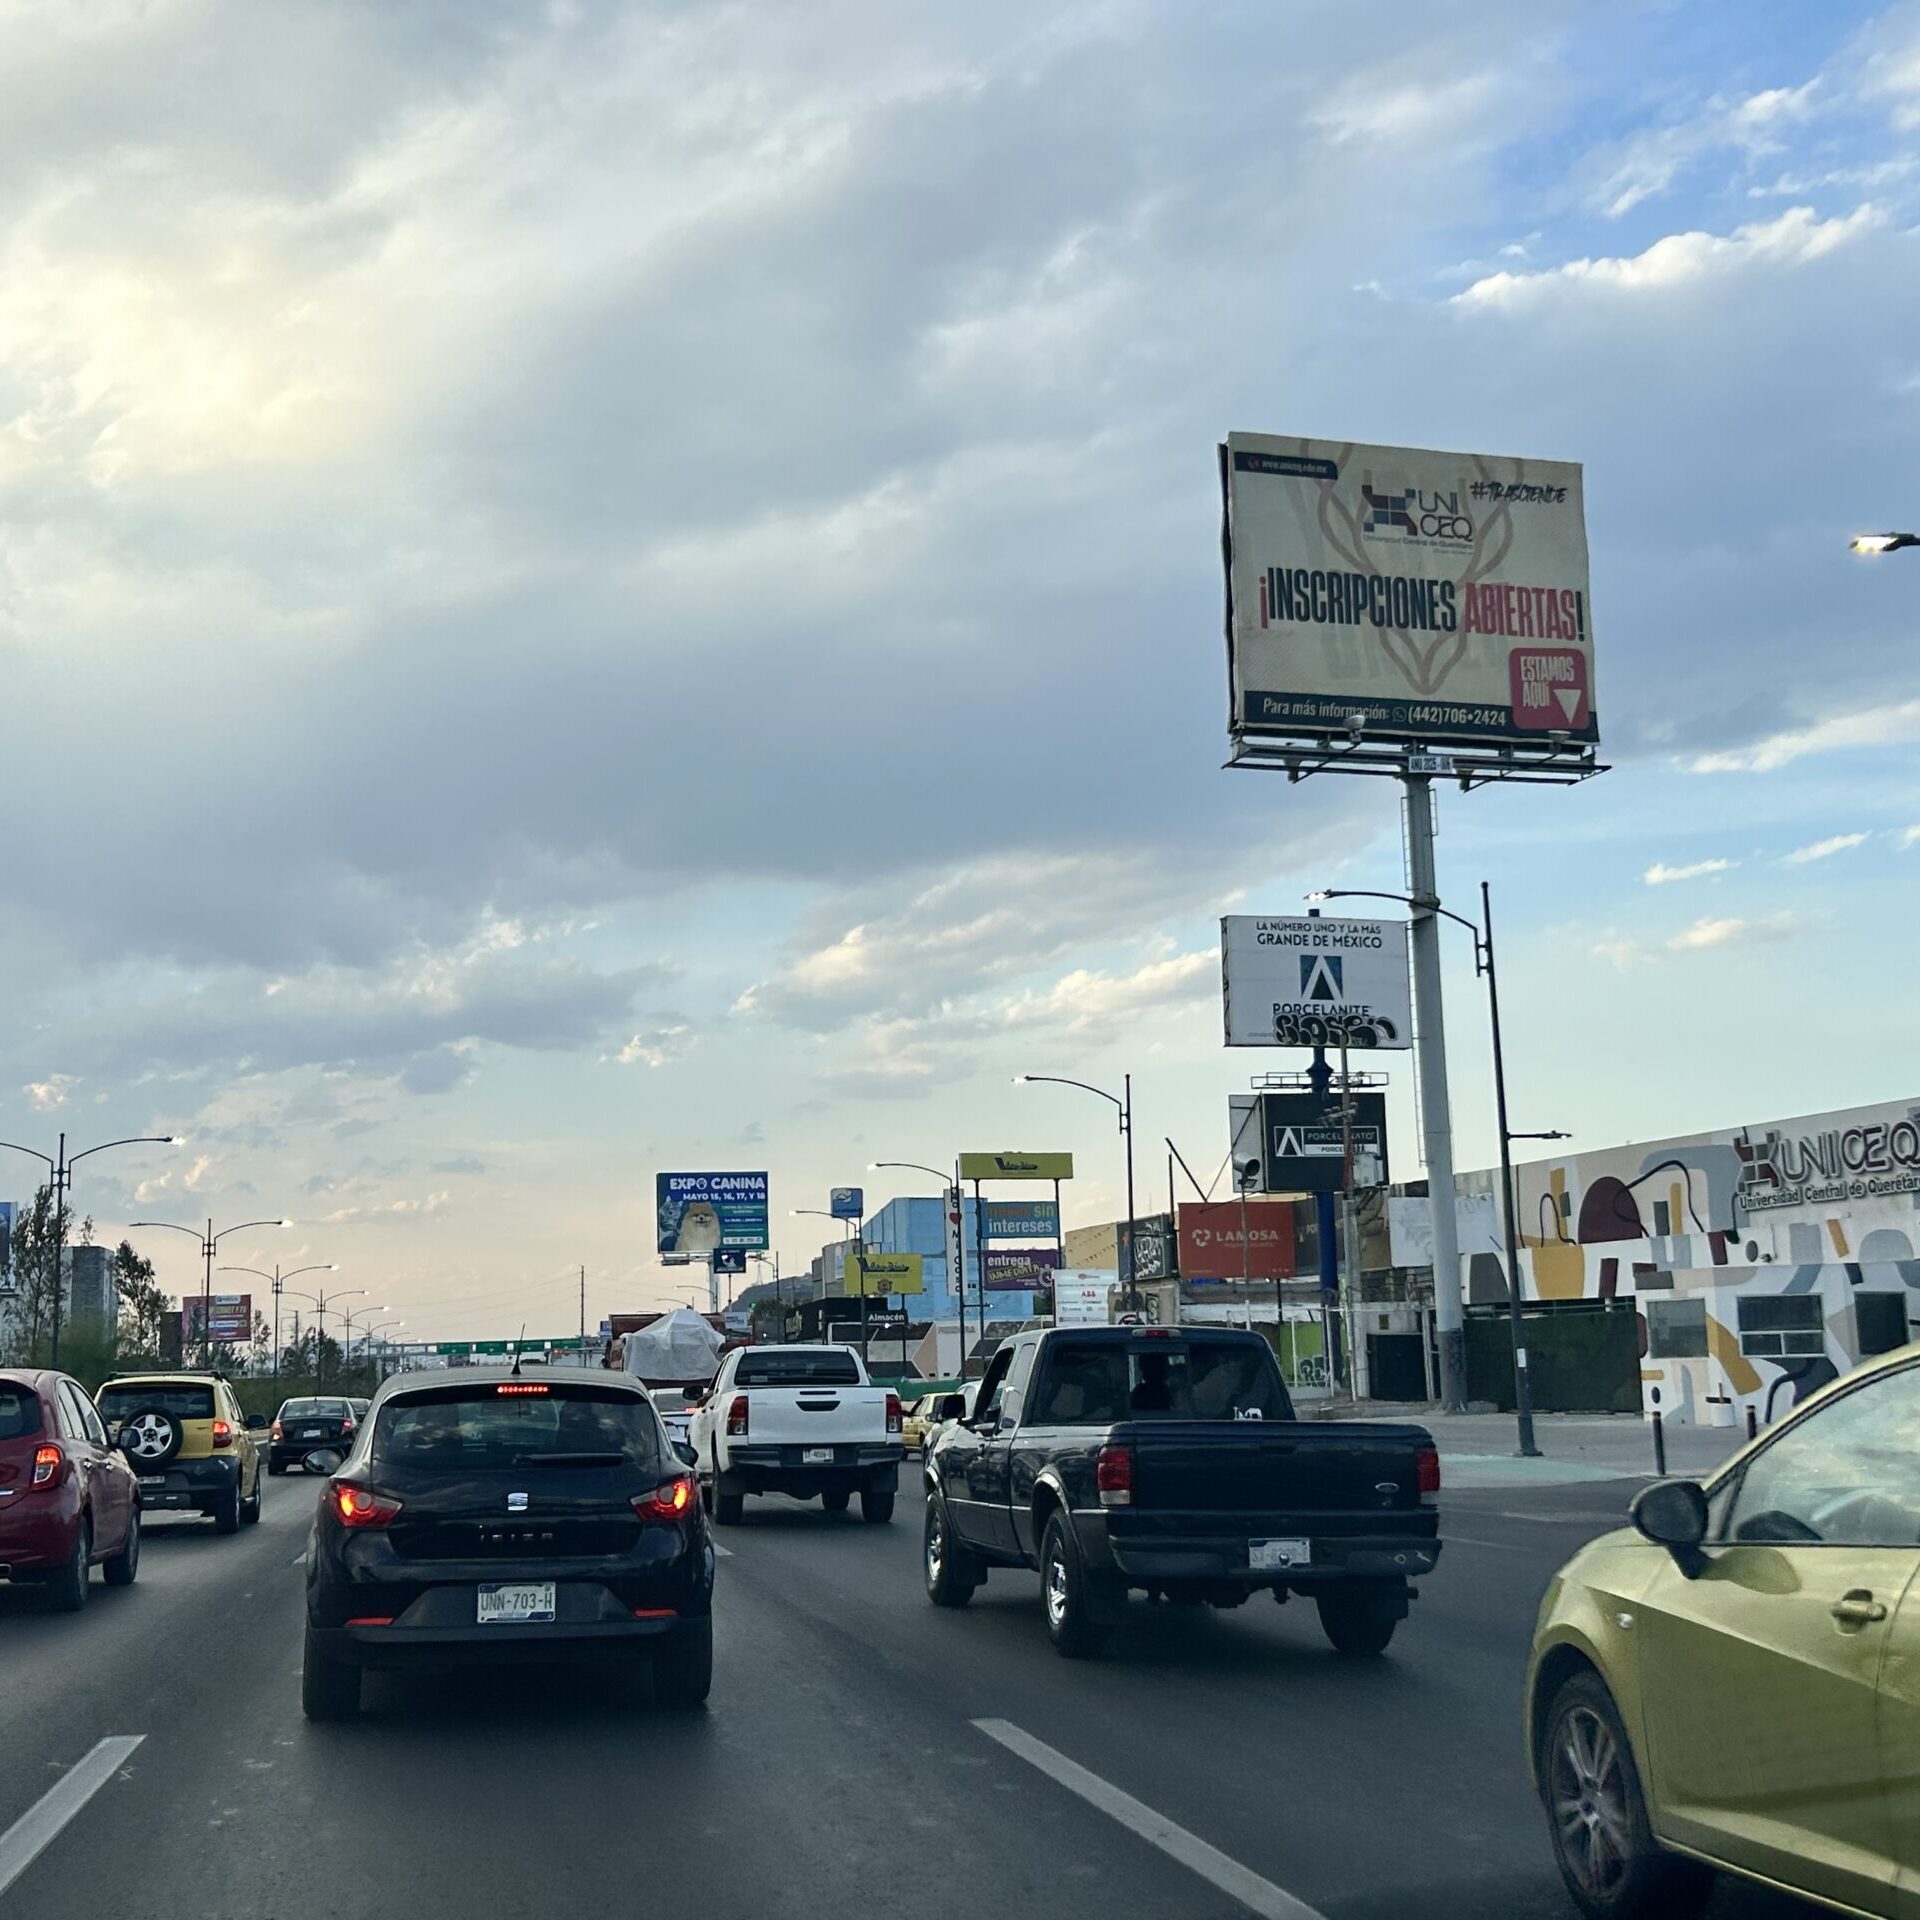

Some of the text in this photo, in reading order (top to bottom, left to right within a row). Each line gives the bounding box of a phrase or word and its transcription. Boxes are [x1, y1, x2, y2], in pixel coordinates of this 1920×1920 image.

[1418, 489, 1458, 515] UNI
[1420, 514, 1473, 543] CEQ
[1259, 567, 1585, 642] ¡INSCRIPCIONES ABIERTAS!
[1520, 656, 1575, 682] ESTAMOS
[1263, 698, 1289, 715] Para
[1292, 699, 1316, 716] más
[1256, 920, 1381, 935] LA NÚMERO UNO Y LA MÁS
[1257, 932, 1382, 949] GRANDE DE MÉXICO
[1273, 1003, 1370, 1017] PORCELANITE
[1308, 1132, 1372, 1141] PORCELATO
[1780, 1121, 1920, 1181] UNICEQ
[670, 1177, 766, 1190] EXPO CANINA
[683, 1192, 709, 1201] MAYO
[710, 1192, 722, 1202] 15,
[749, 1192, 755, 1200] Y
[1740, 1173, 1920, 1210] Universidad Central de Querétar
[1034, 1204, 1054, 1217] sin
[988, 1219, 1053, 1233] intereses
[1216, 1229, 1279, 1242] LAMOSA
[987, 1255, 1031, 1269] entrega
[868, 1312, 905, 1322] Almacén
[481, 1591, 553, 1612] UNN-703-H
